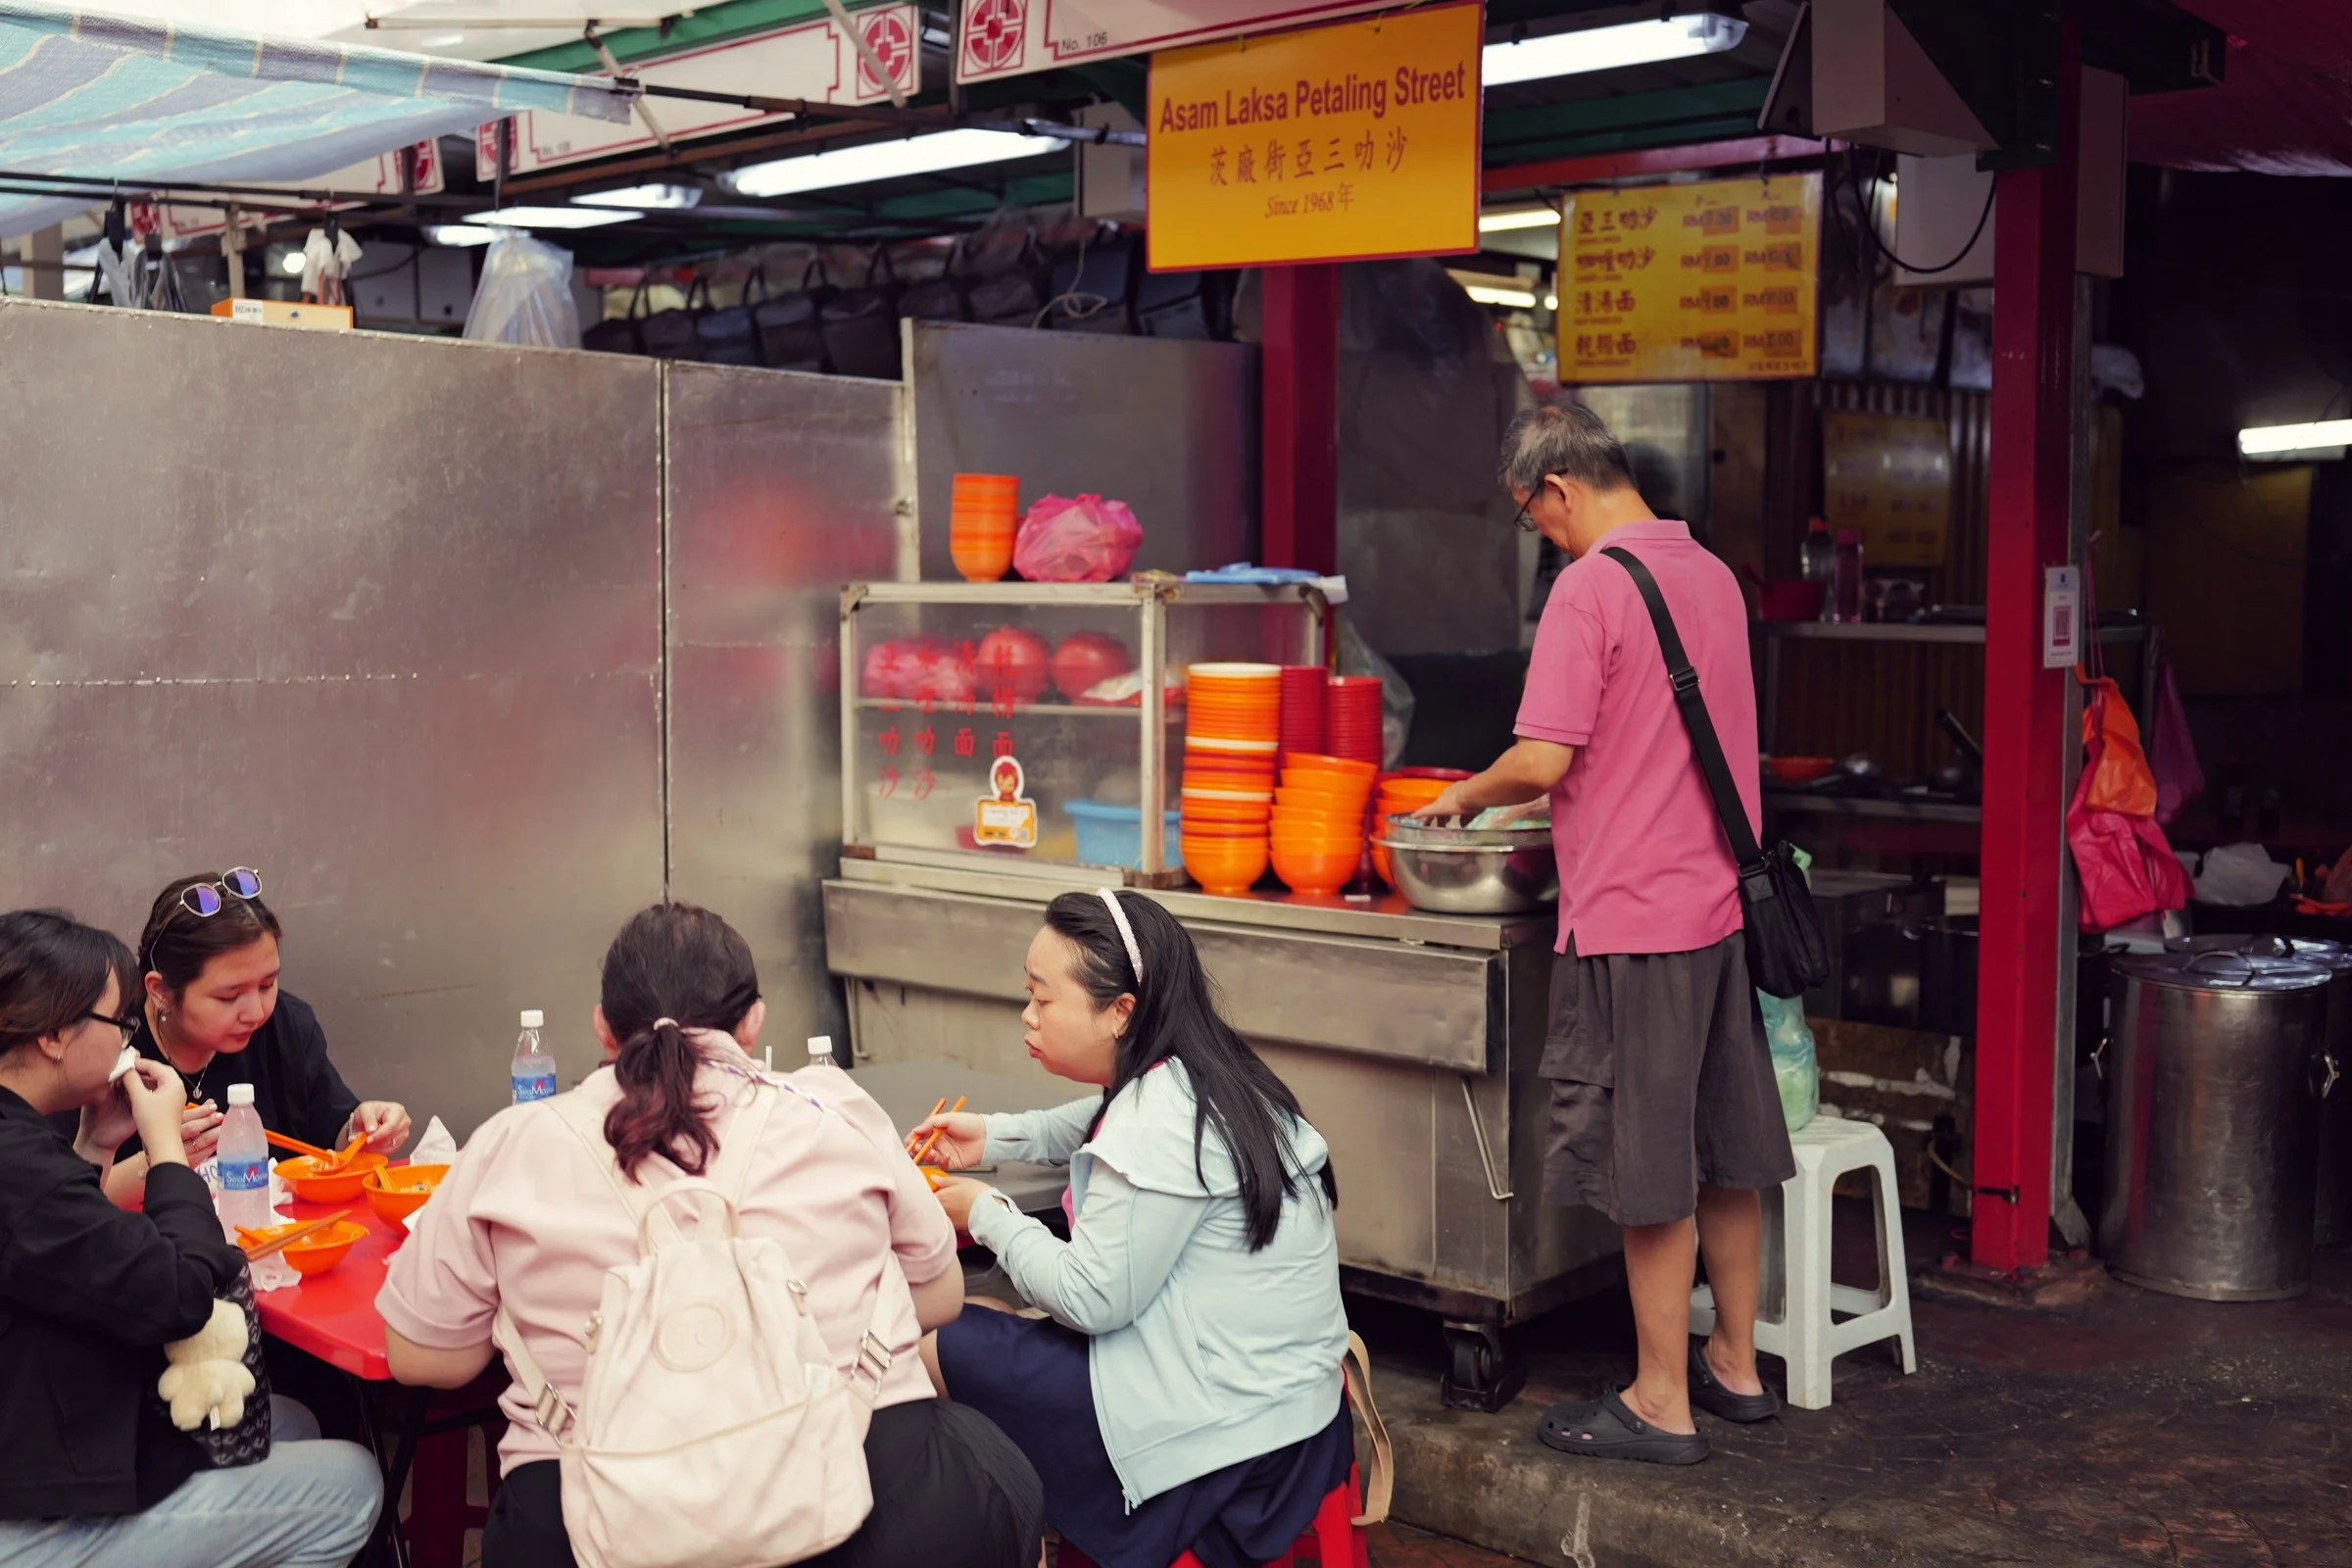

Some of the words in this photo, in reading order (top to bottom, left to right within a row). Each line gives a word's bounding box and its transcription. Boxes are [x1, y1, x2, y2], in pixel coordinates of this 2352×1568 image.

[1159, 98, 1218, 133] Asam
[1225, 87, 1288, 126] Laksa
[1295, 74, 1387, 119] Petaling
[1395, 61, 1465, 106] Street
[1209, 126, 1408, 186] 茨廠街亞三叻沙
[1264, 195, 1298, 219] Since
